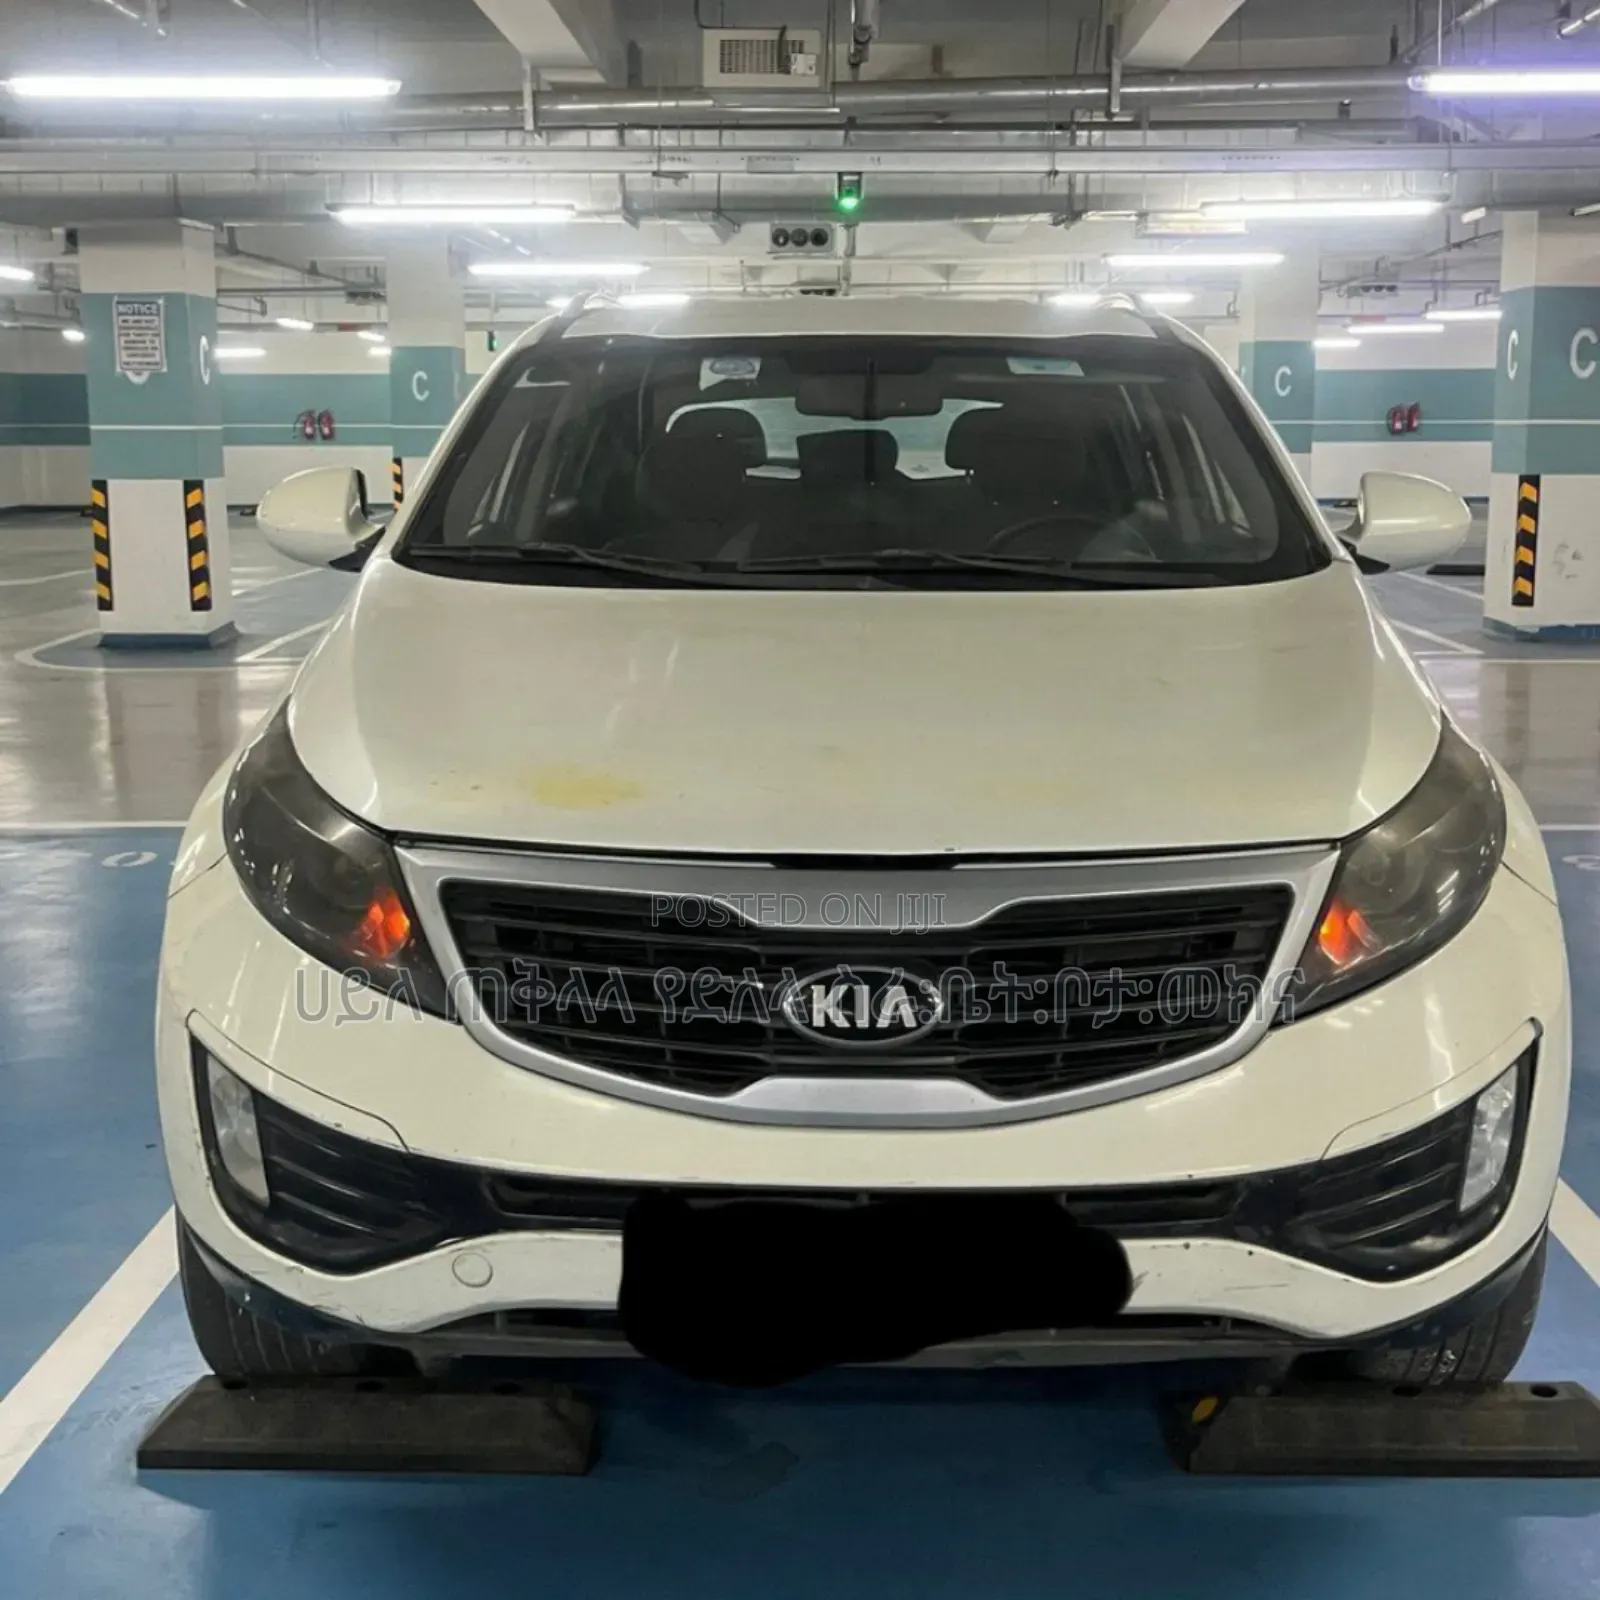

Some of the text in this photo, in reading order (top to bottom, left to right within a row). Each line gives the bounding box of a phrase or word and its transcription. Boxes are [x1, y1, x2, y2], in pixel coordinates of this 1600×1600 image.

[117, 303, 159, 315] NOTICE
[199, 335, 211, 385] C
[1507, 329, 1519, 381] C
[1570, 327, 1598, 379] C
[412, 370, 430, 402] C
[1274, 365, 1292, 397] C
[810, 984, 918, 1029] KIA
